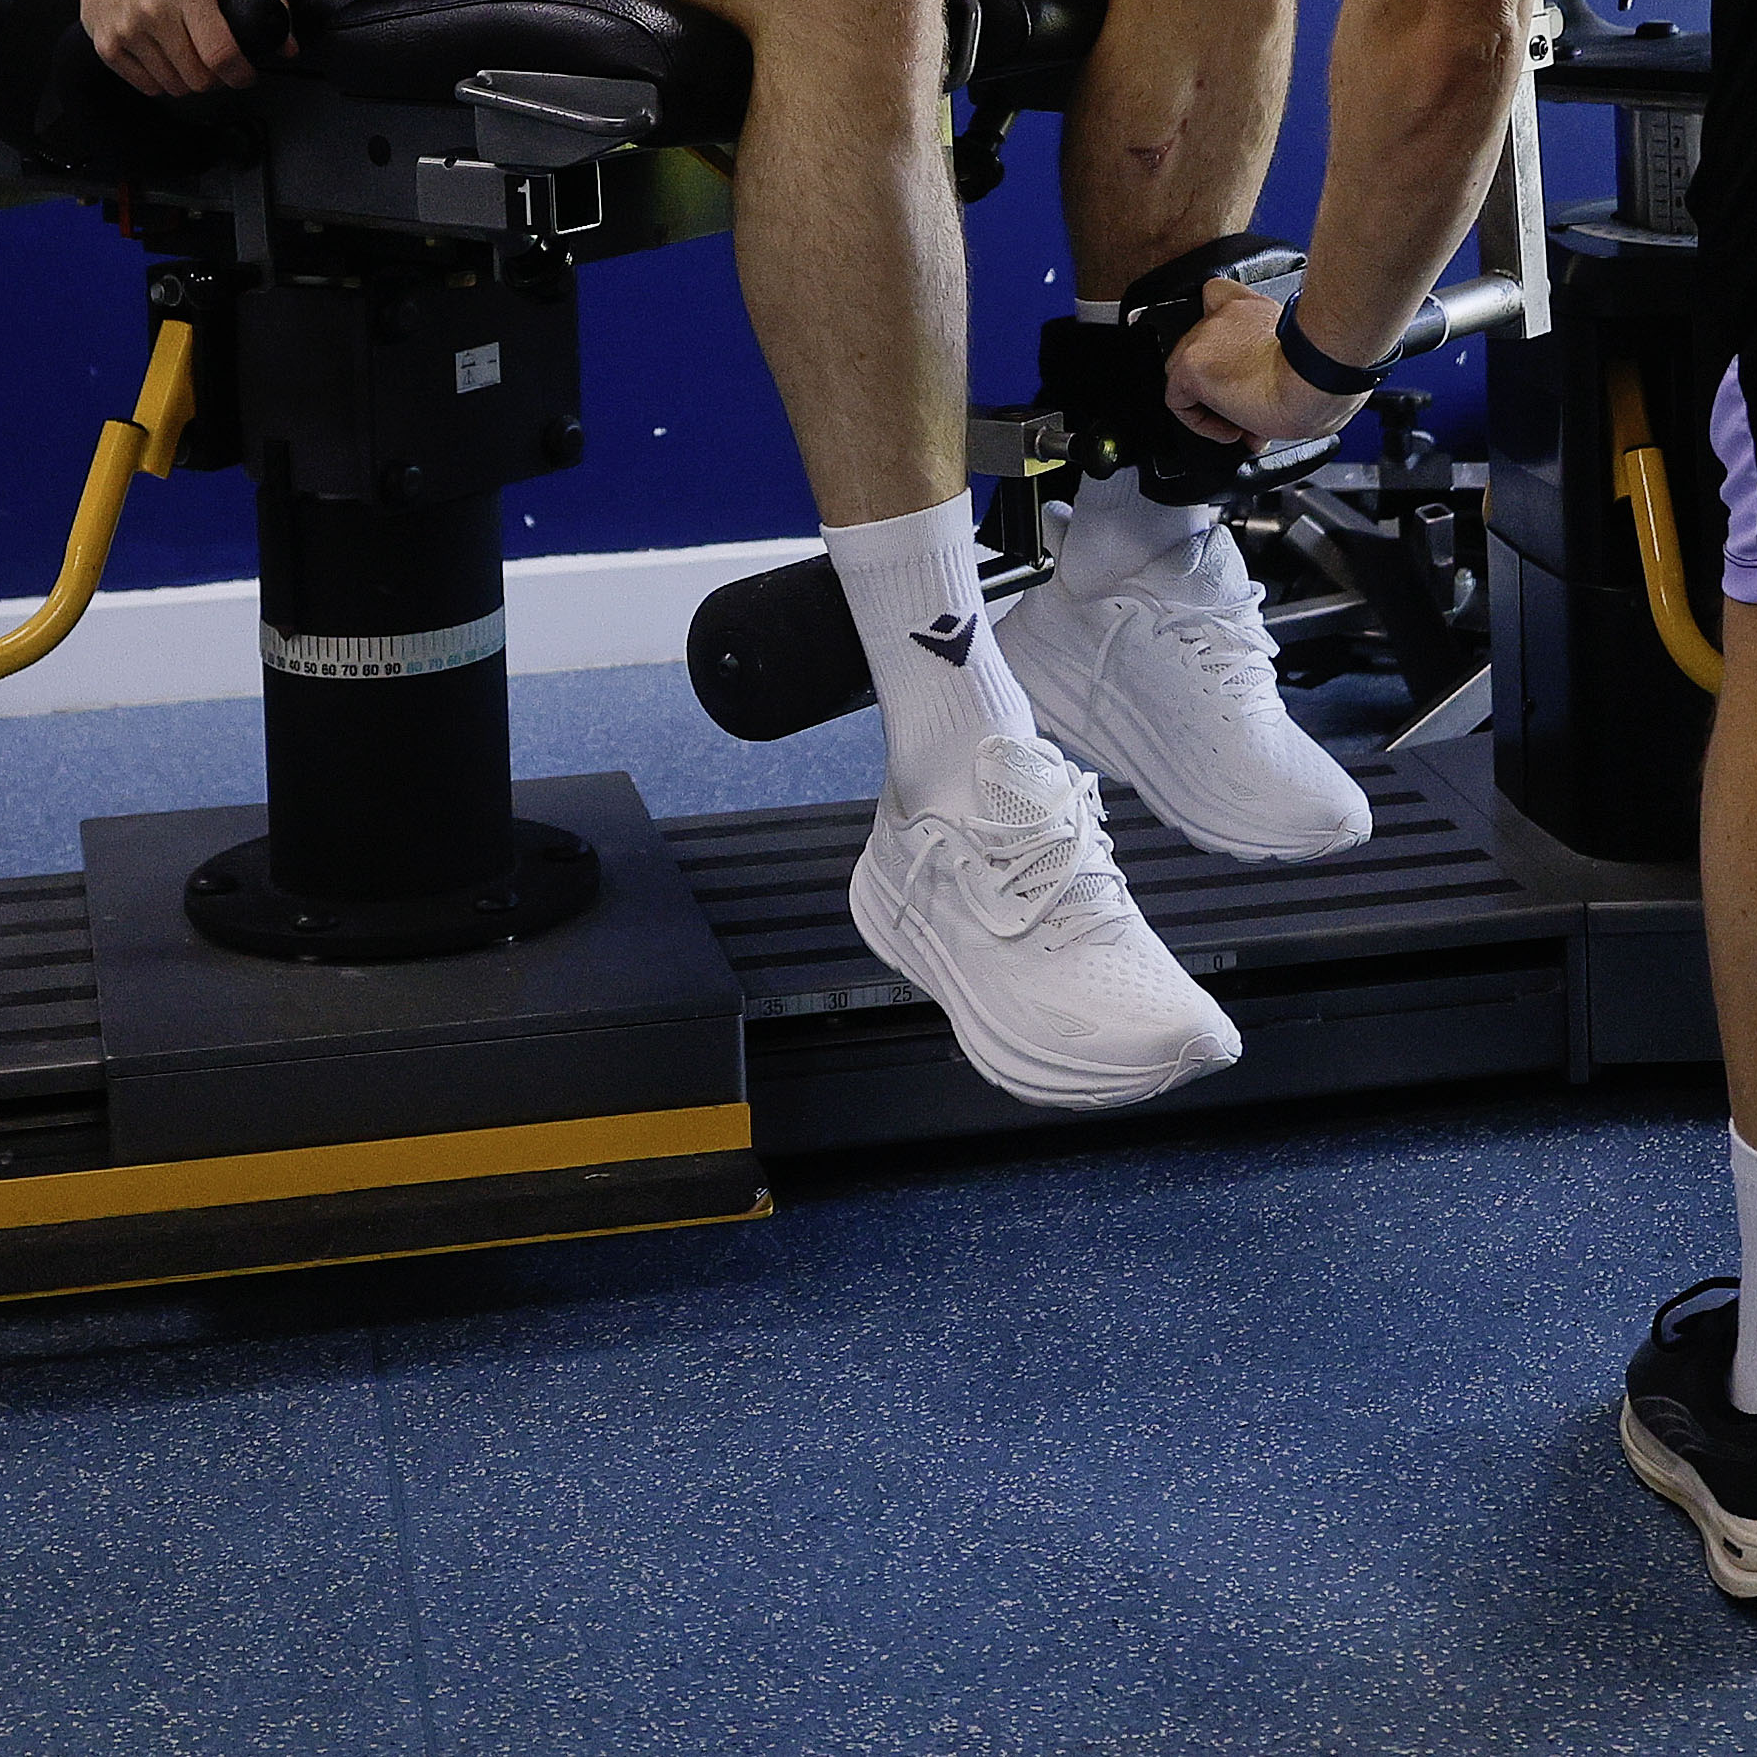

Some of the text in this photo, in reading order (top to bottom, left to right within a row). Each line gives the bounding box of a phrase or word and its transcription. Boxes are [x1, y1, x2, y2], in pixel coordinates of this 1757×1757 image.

[517, 178, 532, 226] 1
[289, 660, 300, 672] 40
[304, 662, 317, 675] 50
[322, 664, 336, 676] 60
[342, 664, 357, 676] 70
[363, 664, 379, 676] 80
[384, 663, 401, 675] 90
[1213, 954, 1223, 971] 0
[763, 986, 912, 1016] 35 30 25
